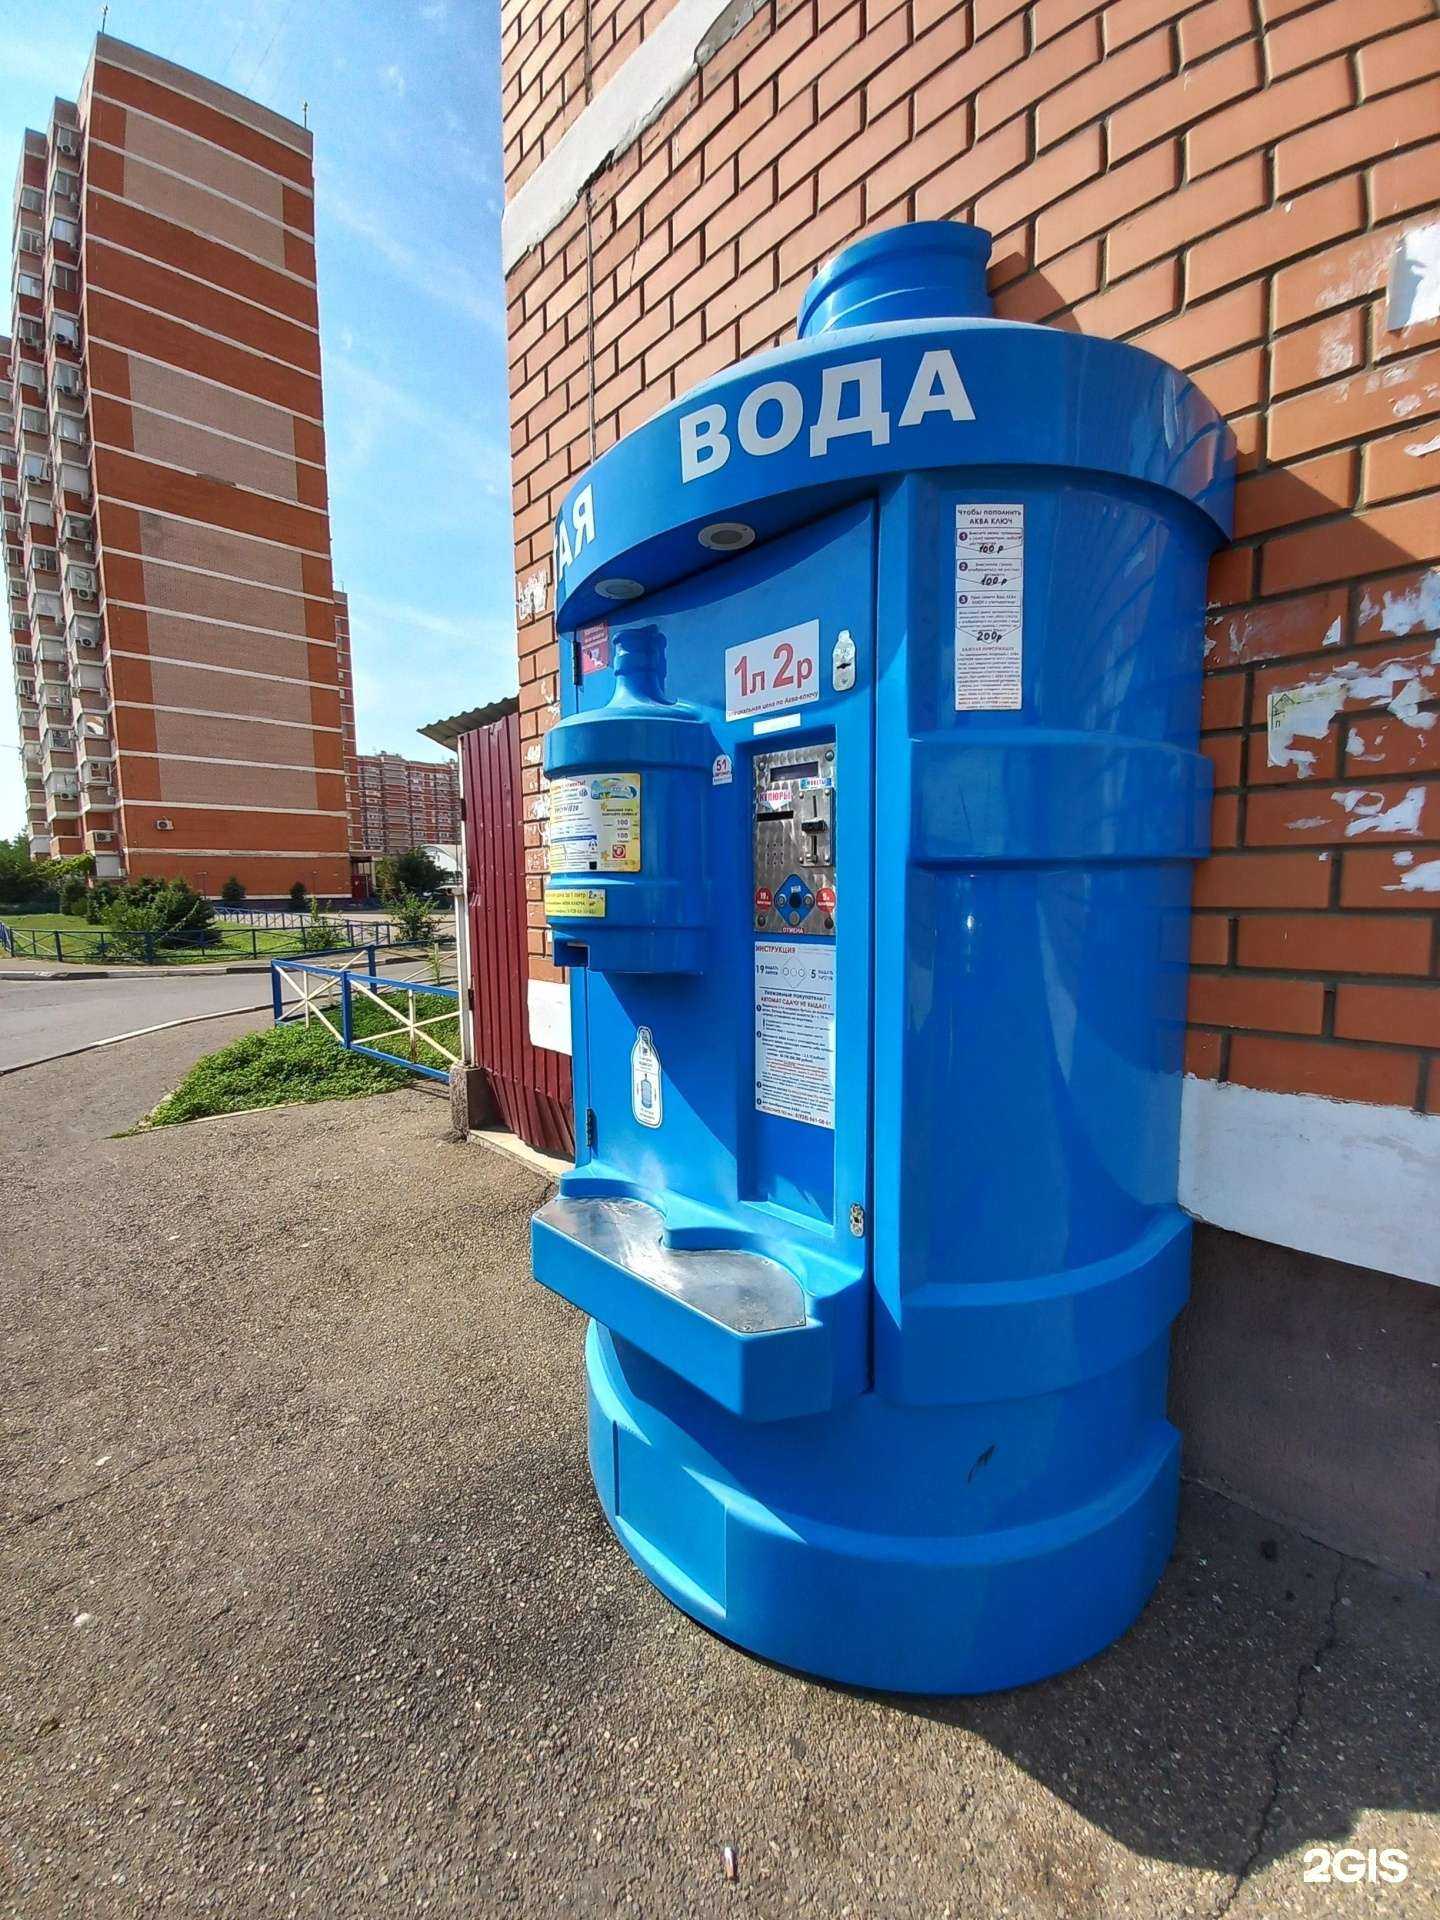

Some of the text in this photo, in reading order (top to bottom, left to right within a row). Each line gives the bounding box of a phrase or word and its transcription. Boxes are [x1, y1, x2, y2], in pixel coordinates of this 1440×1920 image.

[679, 349, 976, 484] ВОДА
[979, 544, 995, 553] 100
[981, 576, 999, 586] 100
[734, 642, 813, 697] 1л 2р
[716, 758, 727, 771] 51
[755, 945, 796, 954] ИНСТРУКЦИЯ
[756, 965, 765, 974] 19
[810, 969, 817, 979] 5
[761, 996, 781, 1004] АВТОМАТ
